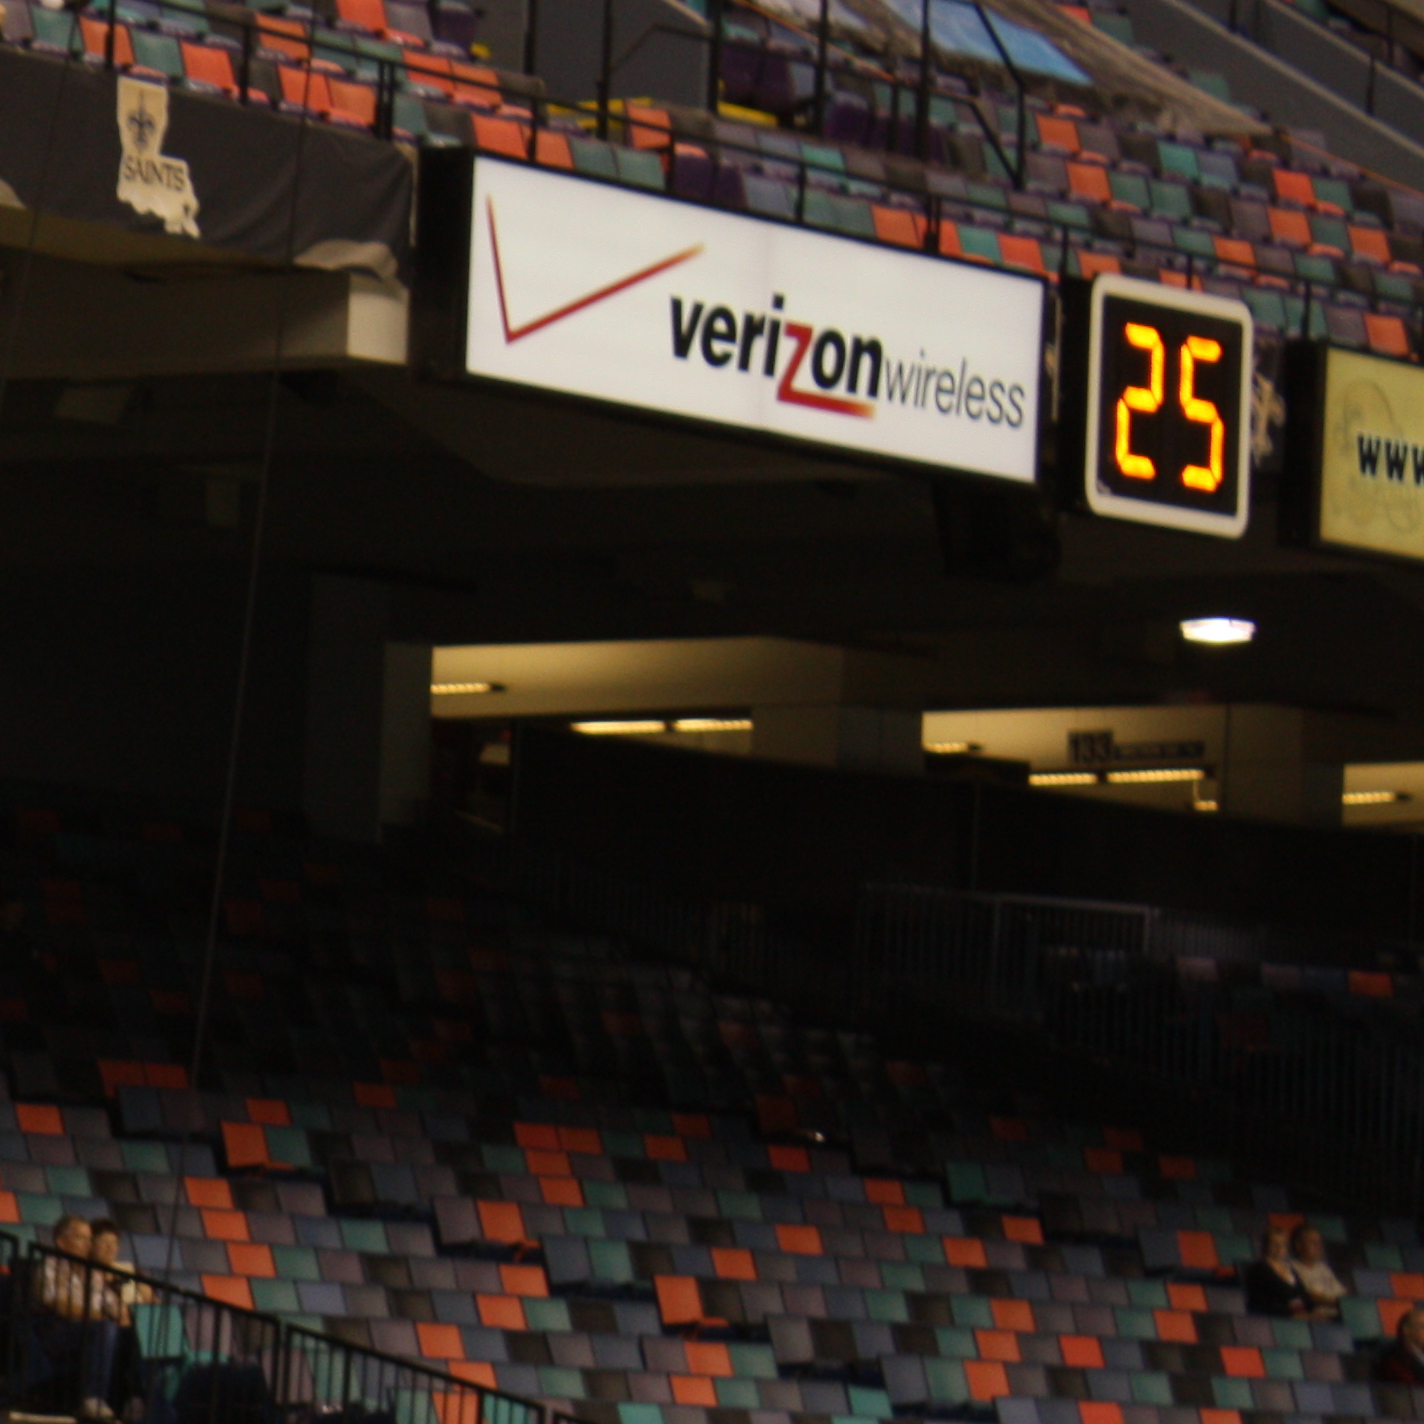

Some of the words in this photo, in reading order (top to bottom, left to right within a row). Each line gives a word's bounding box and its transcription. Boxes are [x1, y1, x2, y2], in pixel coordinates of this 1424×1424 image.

[123, 154, 186, 192] SAINTS
[670, 292, 883, 419] verizon
[885, 346, 1026, 428] wireless
[1115, 321, 1225, 492] 25
